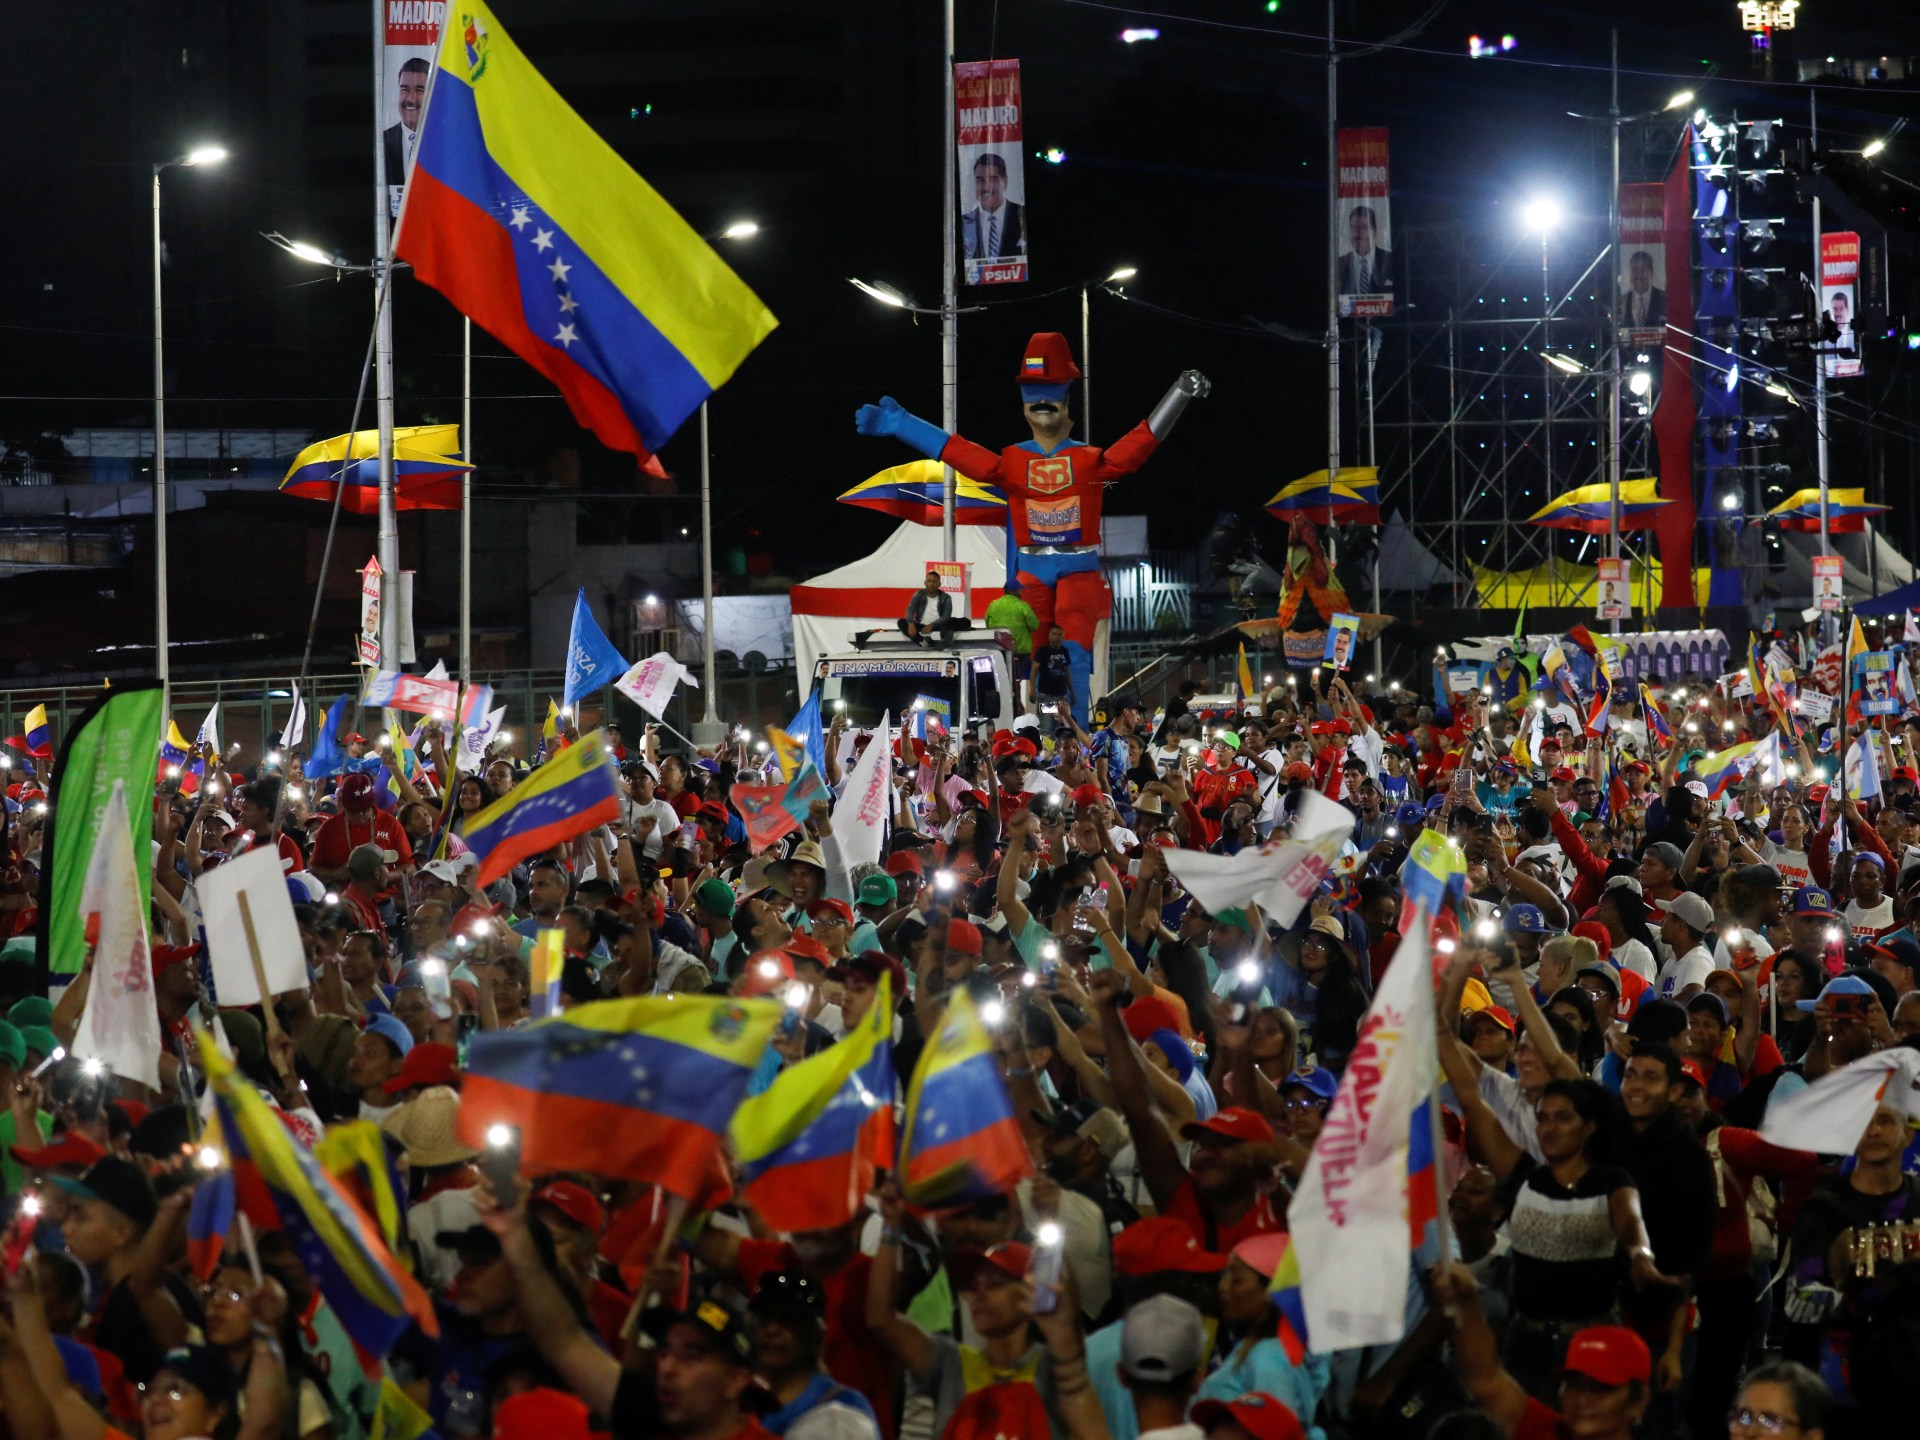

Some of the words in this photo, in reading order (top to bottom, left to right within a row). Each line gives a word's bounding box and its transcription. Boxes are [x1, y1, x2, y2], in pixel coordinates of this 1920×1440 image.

[389, 0, 446, 24] MADUR
[960, 105, 1018, 127] MADURO
[1340, 166, 1386, 183] MADURO
[1823, 261, 1857, 275] MADURO
[940, 576, 962, 589] DURO
[835, 660, 939, 674] ENAMÓRATE
